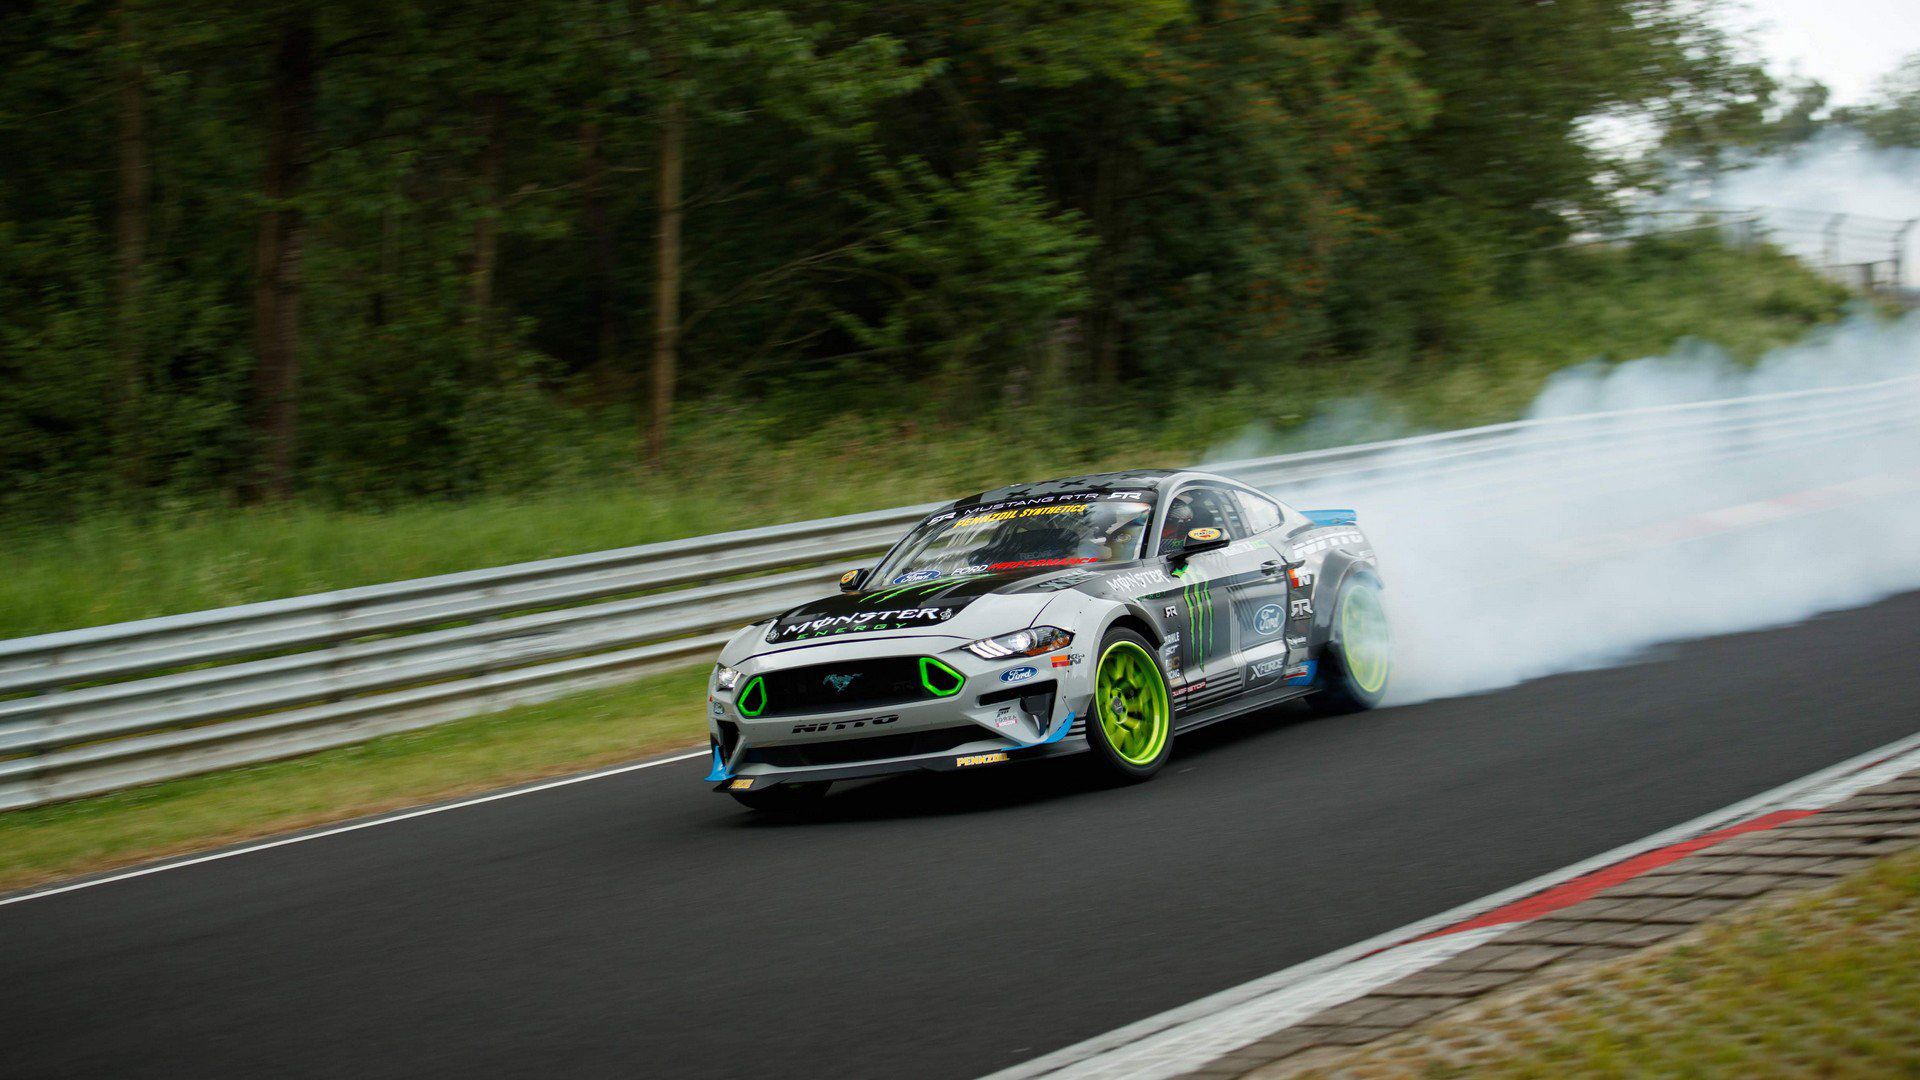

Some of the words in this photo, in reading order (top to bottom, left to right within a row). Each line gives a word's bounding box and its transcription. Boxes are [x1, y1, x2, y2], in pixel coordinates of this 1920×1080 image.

[964, 495, 1055, 515] MUSTANG
[1059, 493, 1099, 501] RTR
[952, 510, 1018, 529] PENNZOIL
[1019, 503, 1089, 518] SYNTHETICS
[950, 564, 989, 576] FORD
[986, 557, 1100, 572] PERFORMANCE
[796, 622, 907, 640] ENERGY
[1007, 667, 1034, 682] Ford
[792, 714, 899, 734] NITTO
